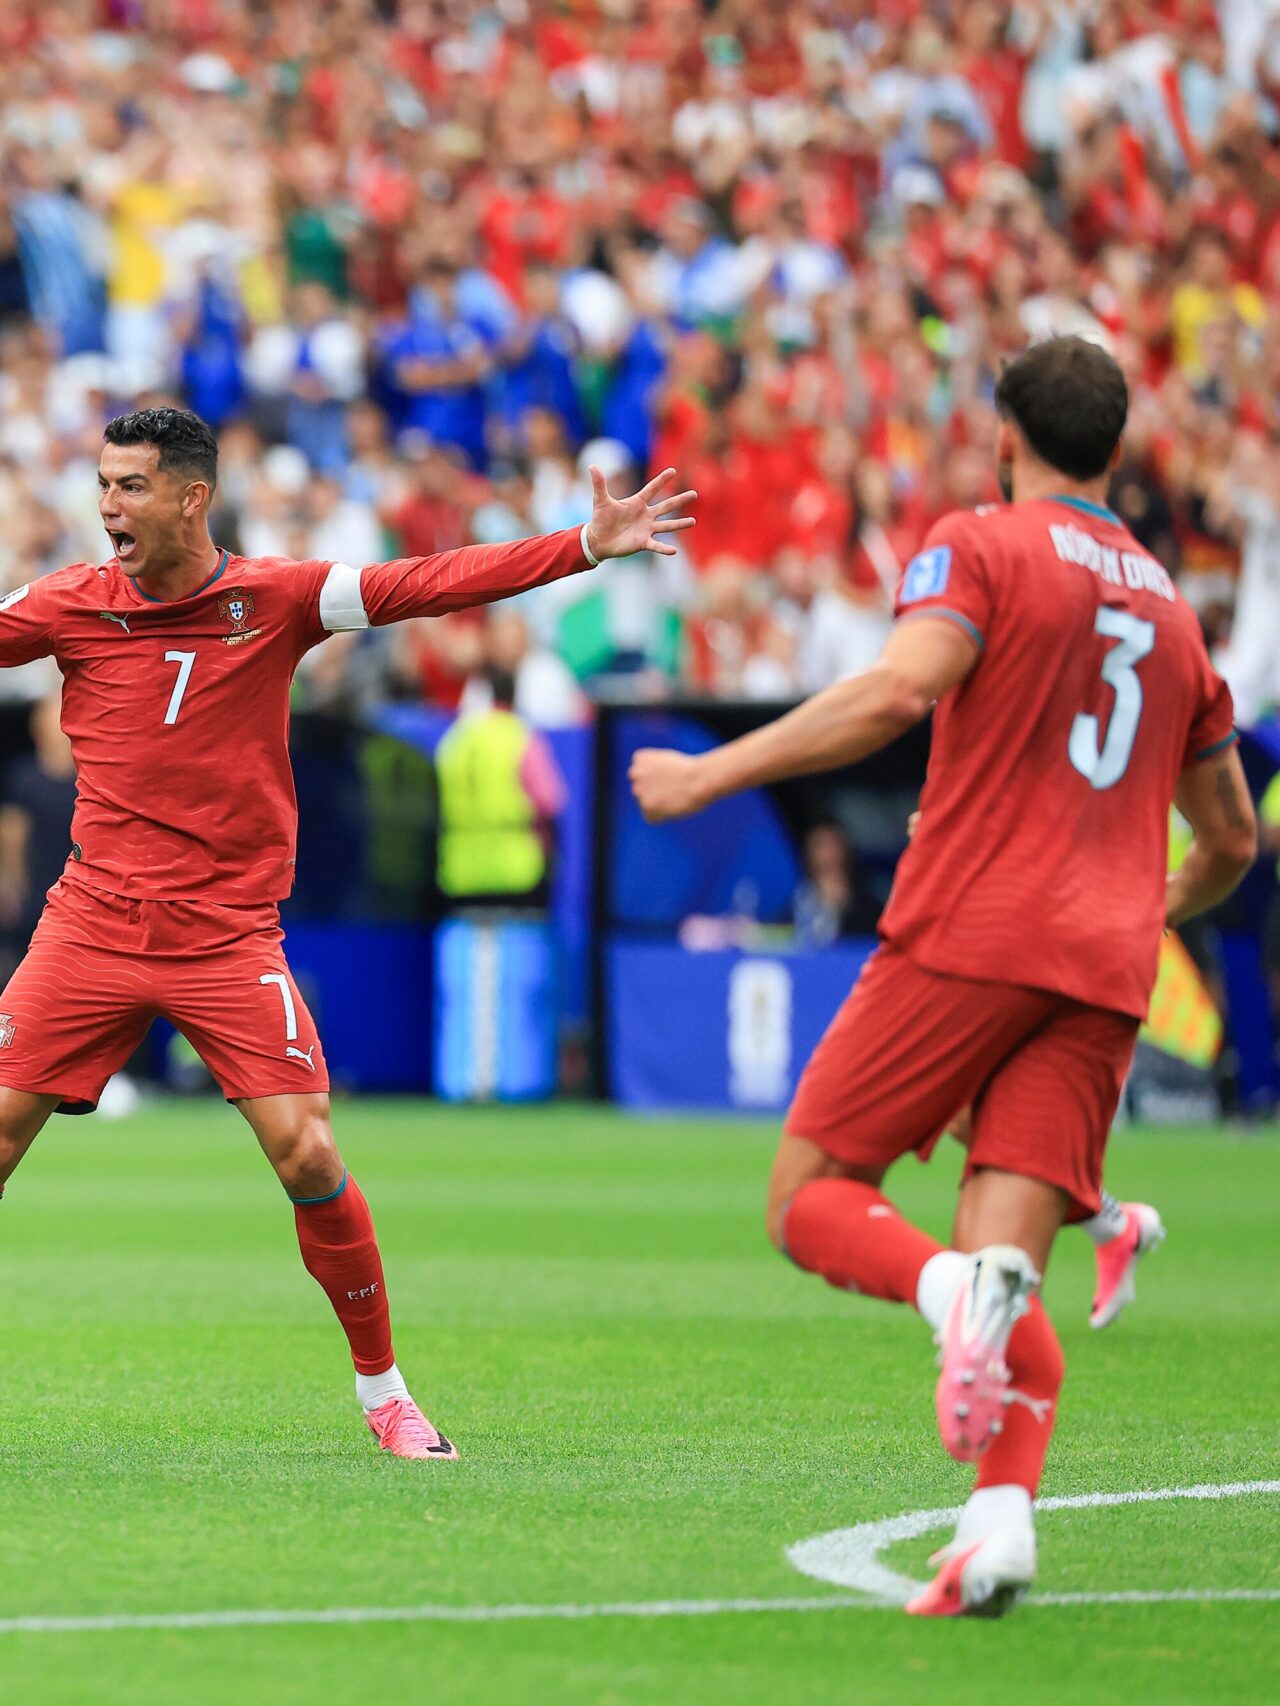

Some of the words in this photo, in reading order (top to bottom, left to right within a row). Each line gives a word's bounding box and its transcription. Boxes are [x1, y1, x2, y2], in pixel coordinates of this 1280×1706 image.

[164, 650, 197, 725] 7
[1068, 605, 1155, 790] 3
[259, 973, 298, 1041] 7
